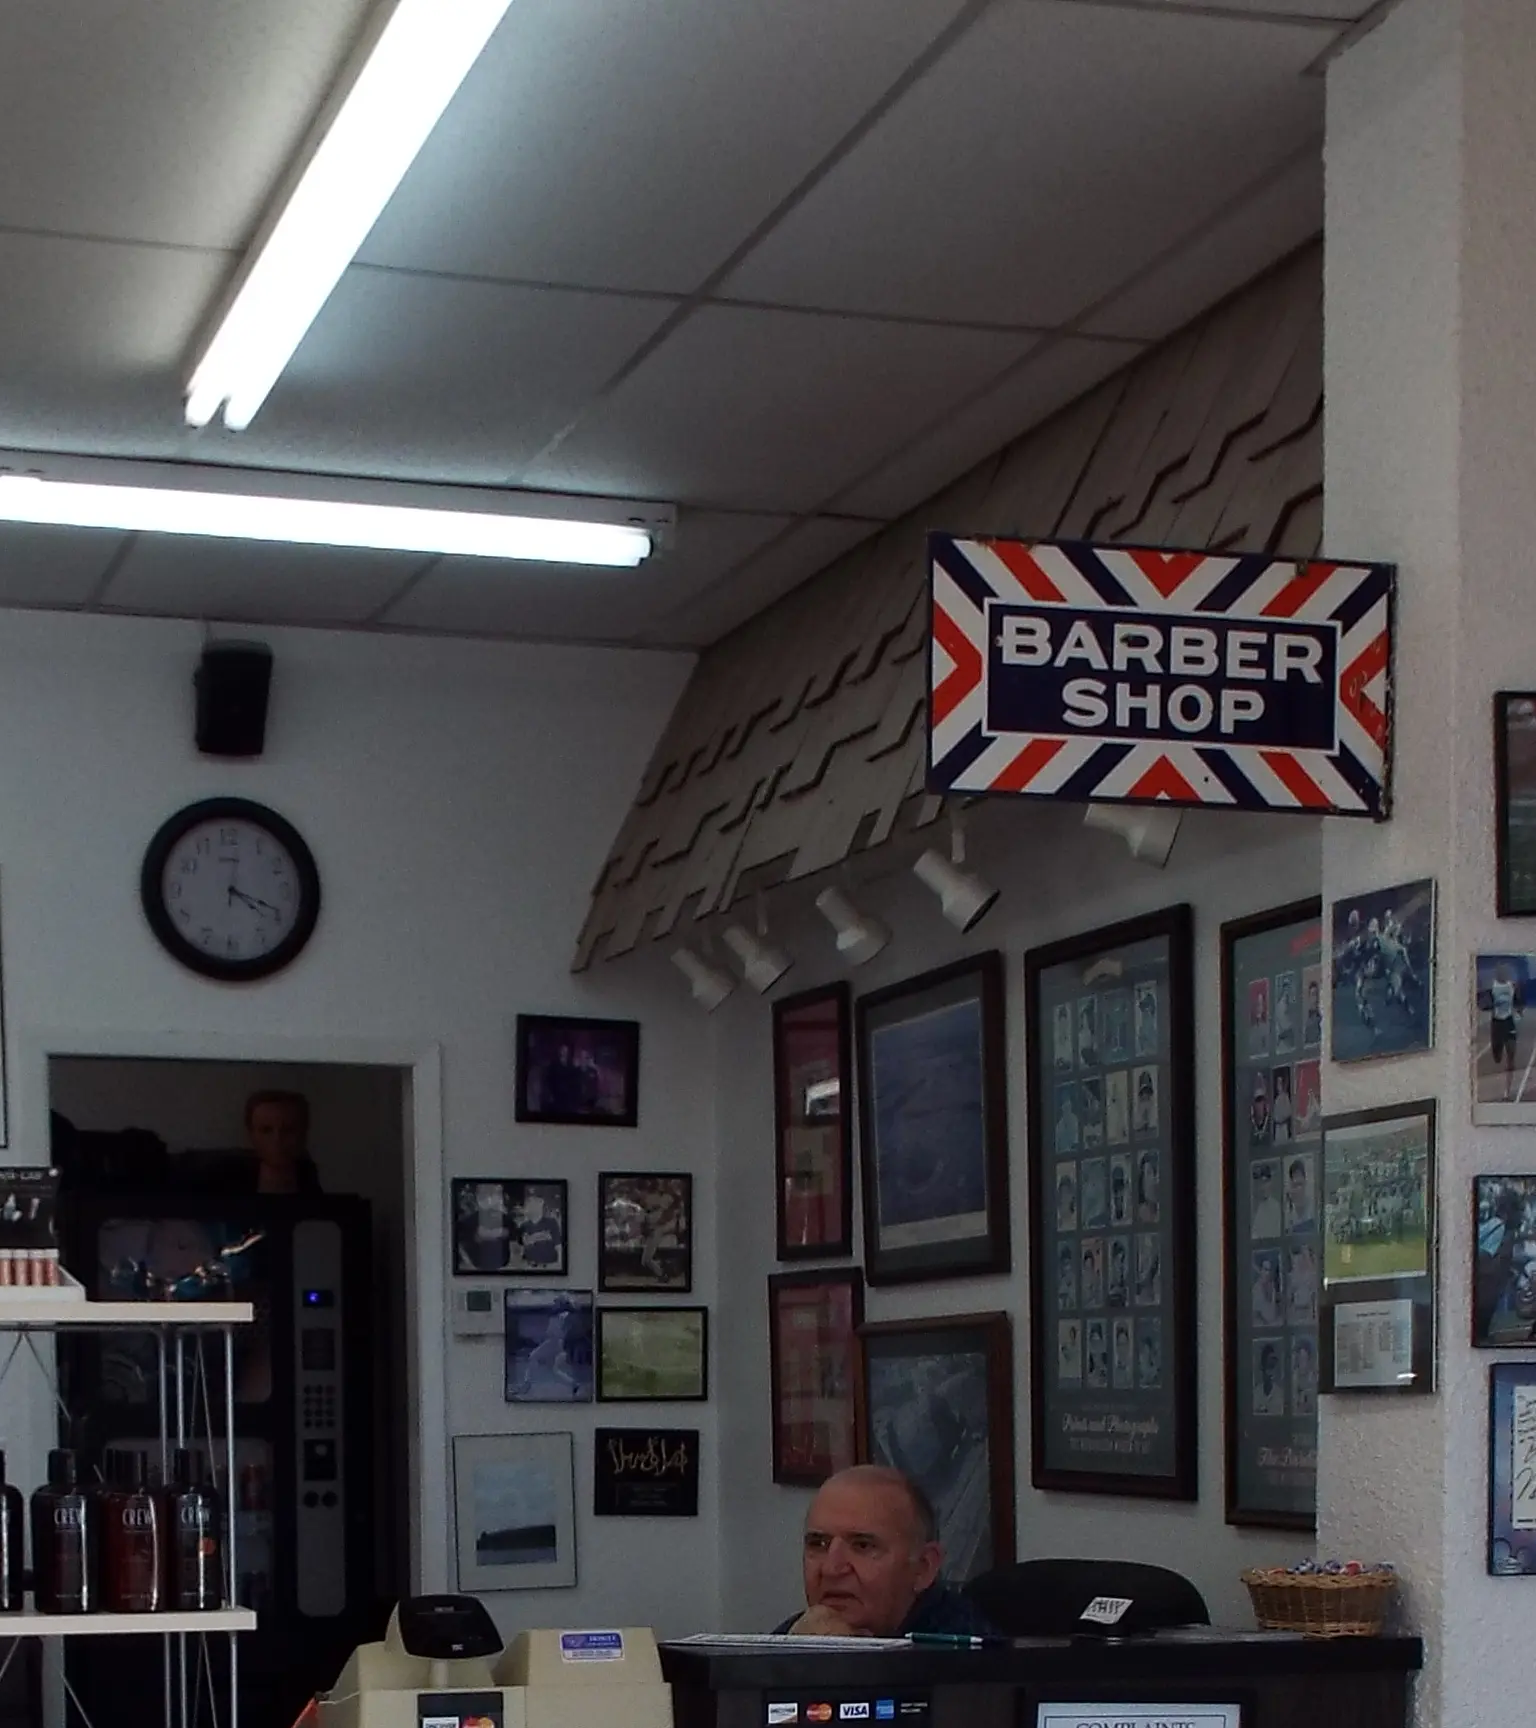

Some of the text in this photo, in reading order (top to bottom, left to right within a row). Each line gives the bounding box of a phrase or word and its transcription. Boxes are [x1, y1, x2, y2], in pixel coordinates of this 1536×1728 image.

[1000, 614, 1324, 685] BARBER
[1061, 677, 1265, 735] SHOP
[122, 1507, 154, 1526] CREW
[842, 1705, 868, 1717] VISA
